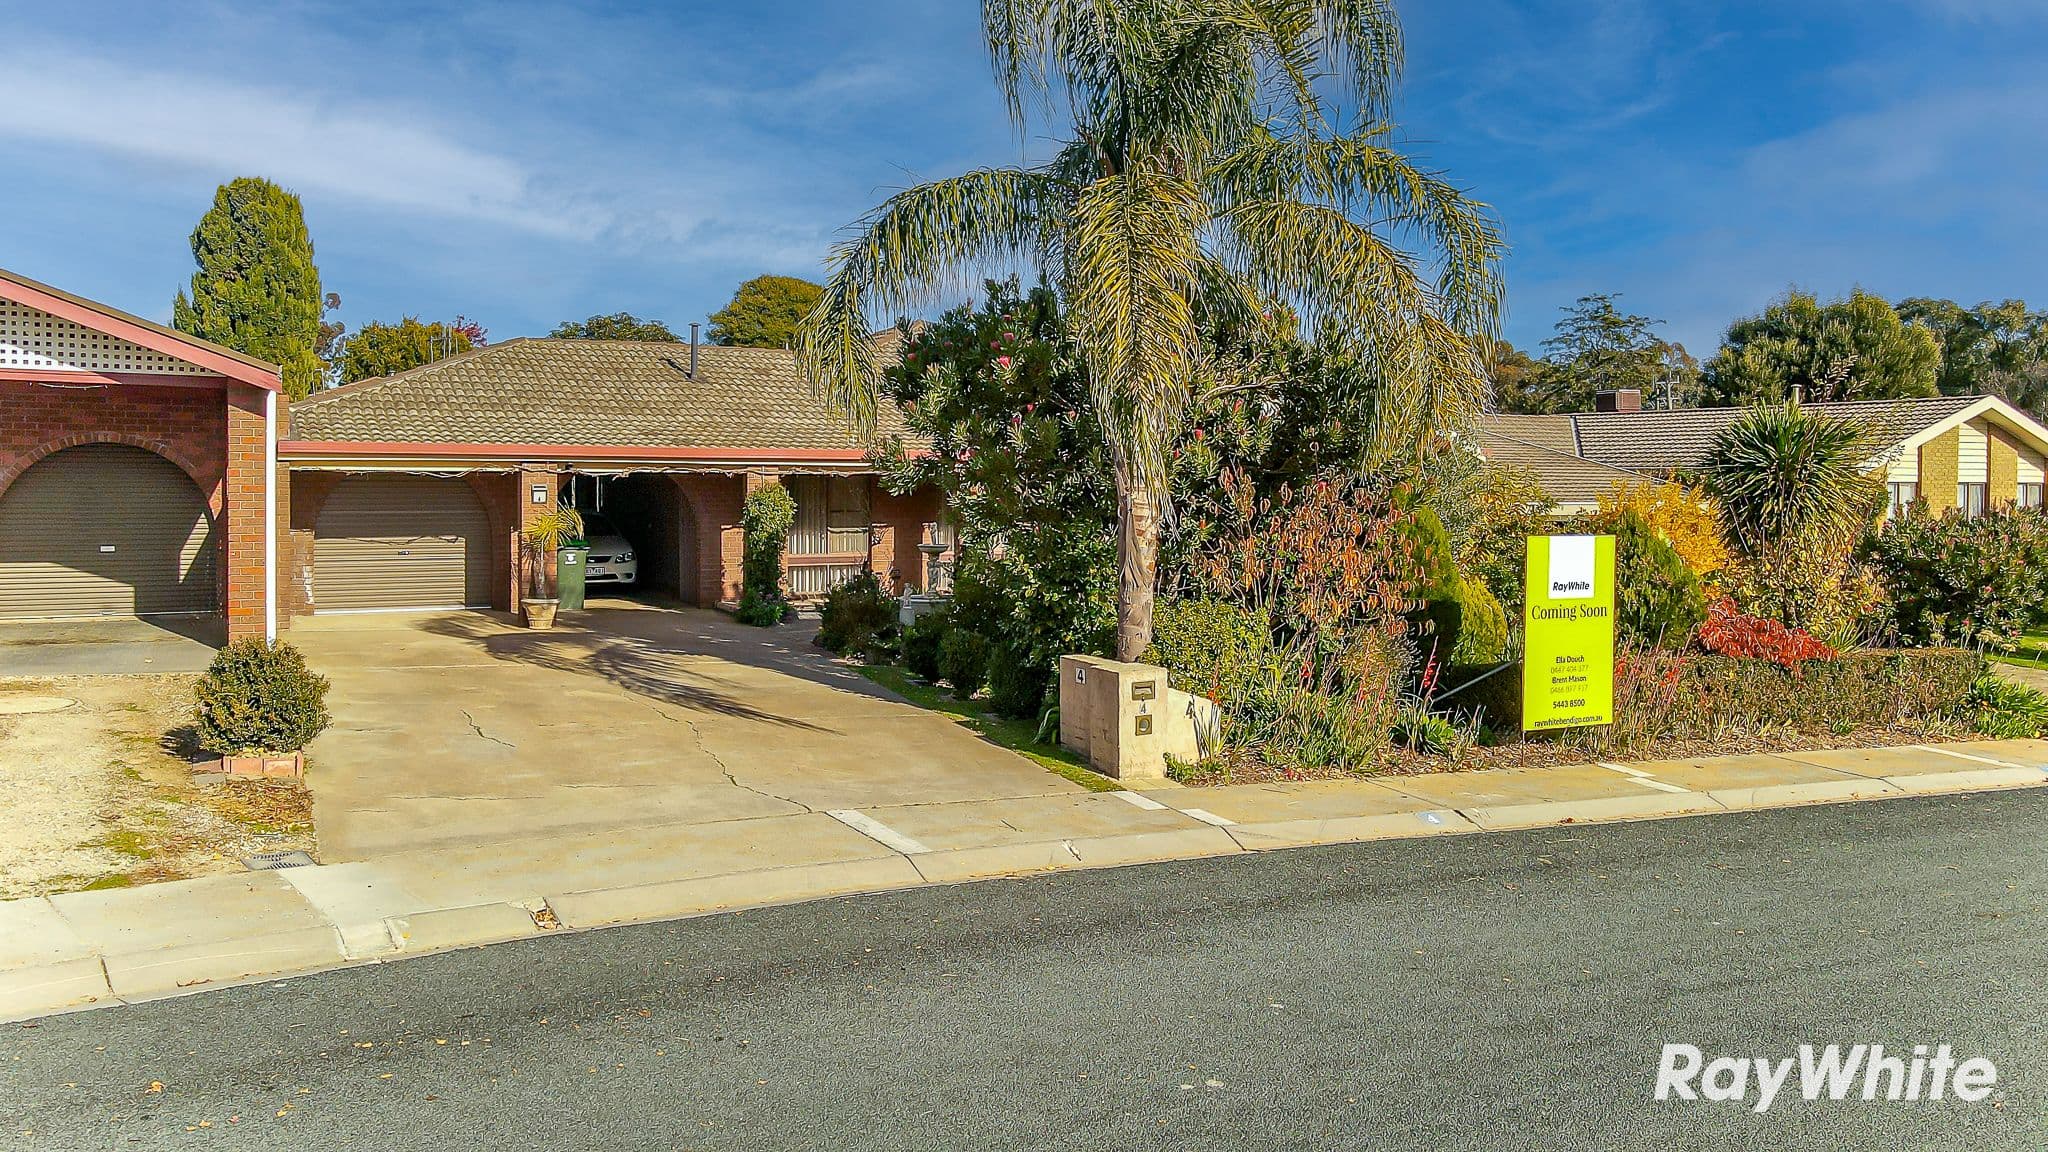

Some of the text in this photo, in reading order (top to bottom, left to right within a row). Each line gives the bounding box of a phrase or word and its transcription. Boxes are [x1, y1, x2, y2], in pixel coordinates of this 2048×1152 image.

[1553, 581, 1590, 592] RayWhite
[1532, 603, 1608, 621] Coming Soon
[1077, 669, 1084, 684] 4
[1552, 675, 1587, 684] Brent Mason
[1140, 703, 1147, 714] 4
[1552, 698, 1586, 709] 5443 8500
[1534, 715, 1603, 728] raywhitebendigo.com.au
